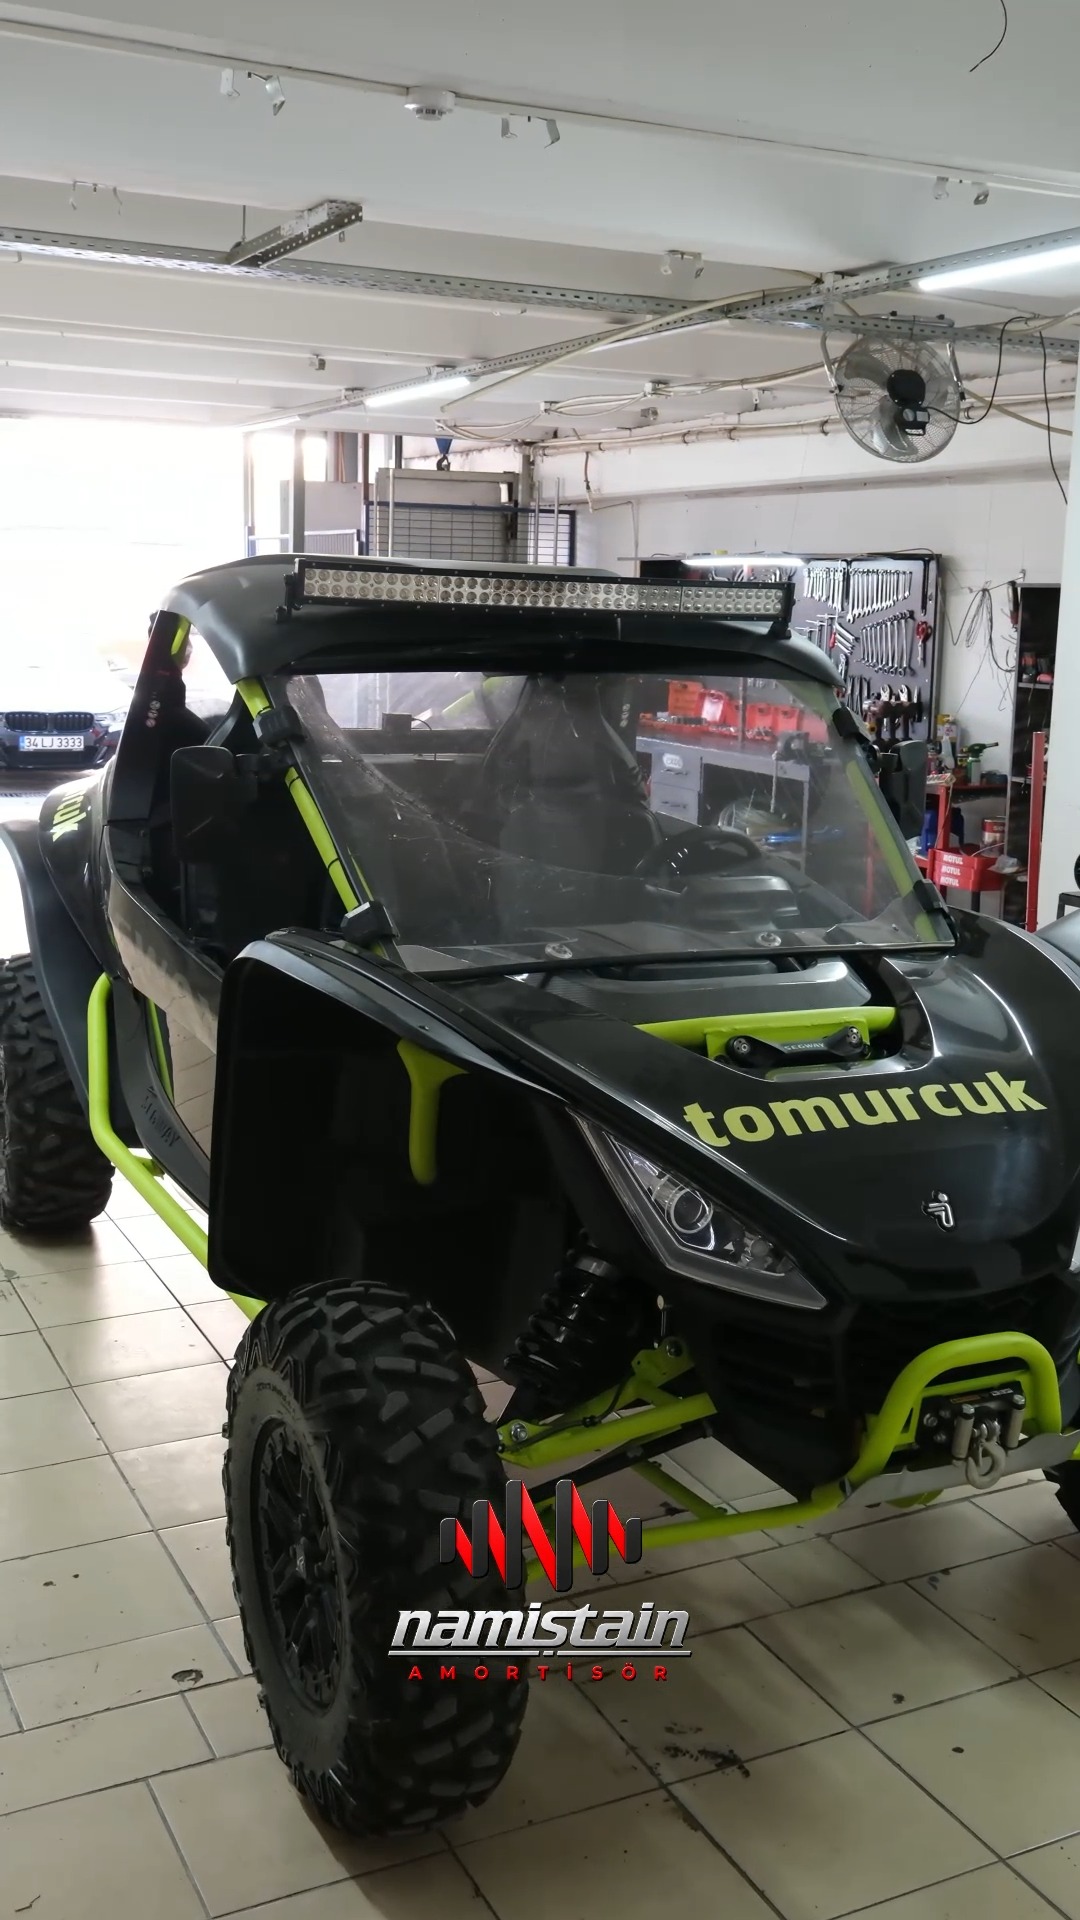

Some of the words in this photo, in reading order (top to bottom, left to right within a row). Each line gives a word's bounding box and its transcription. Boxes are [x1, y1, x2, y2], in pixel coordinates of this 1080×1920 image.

[25, 737, 38, 748] 34
[41, 737, 54, 748] LJ
[57, 737, 83, 748] 3333
[943, 854, 963, 865] MOTUL
[941, 864, 961, 876] MOTUL
[940, 875, 959, 886] MOTUL
[783, 1042, 825, 1051] SEGWAY
[683, 1071, 1048, 1148] tomurcuk
